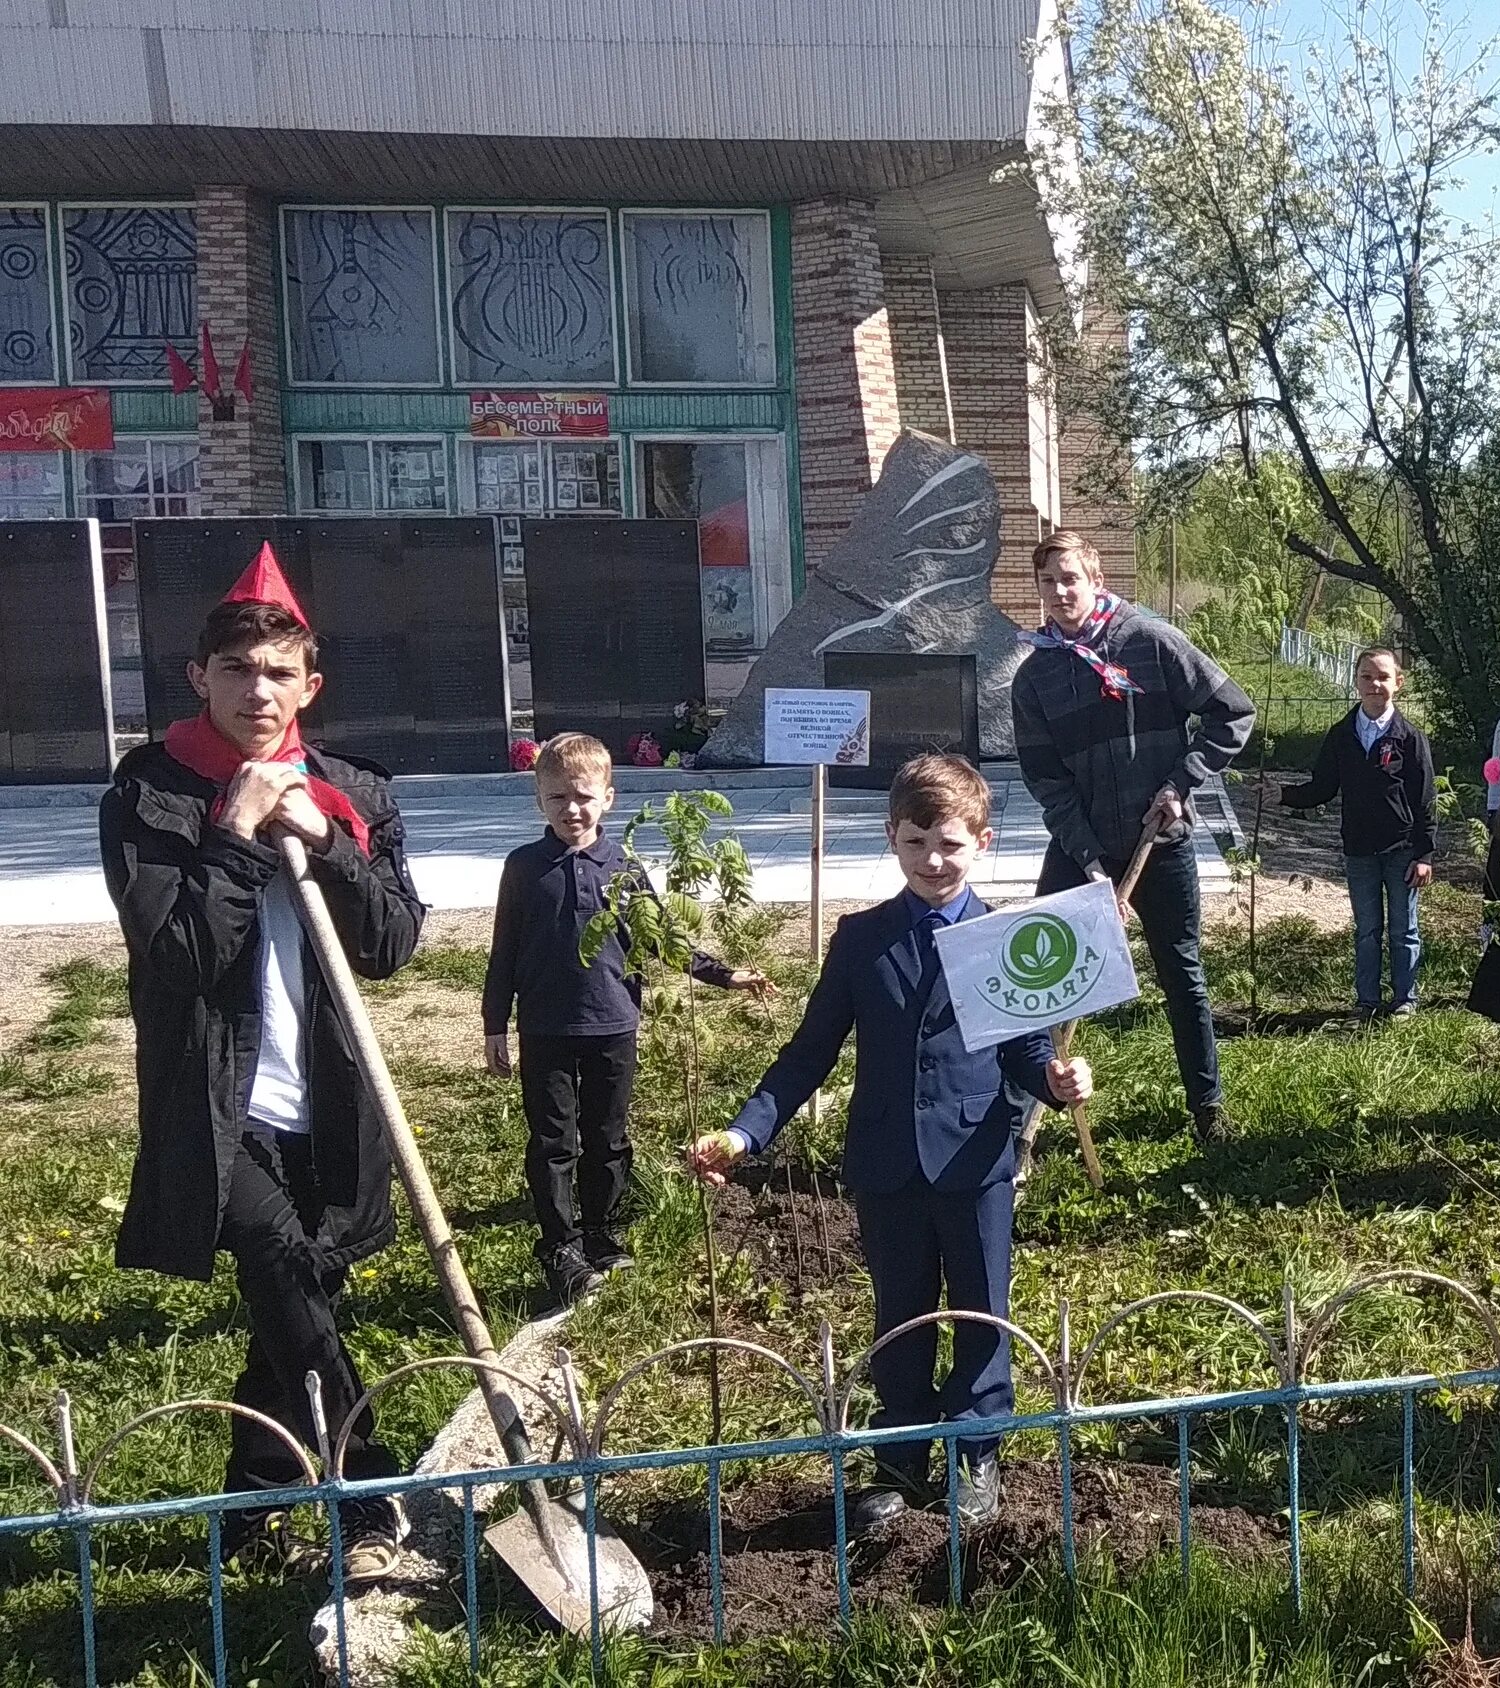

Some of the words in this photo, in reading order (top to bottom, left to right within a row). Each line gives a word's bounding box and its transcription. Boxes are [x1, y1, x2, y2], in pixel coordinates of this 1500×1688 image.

[472, 399, 604, 415] БЕССМЕРТНЫЙ
[516, 419, 562, 432] ПОЛК
[985, 945, 1101, 1012] ЭКОЛЯТА
